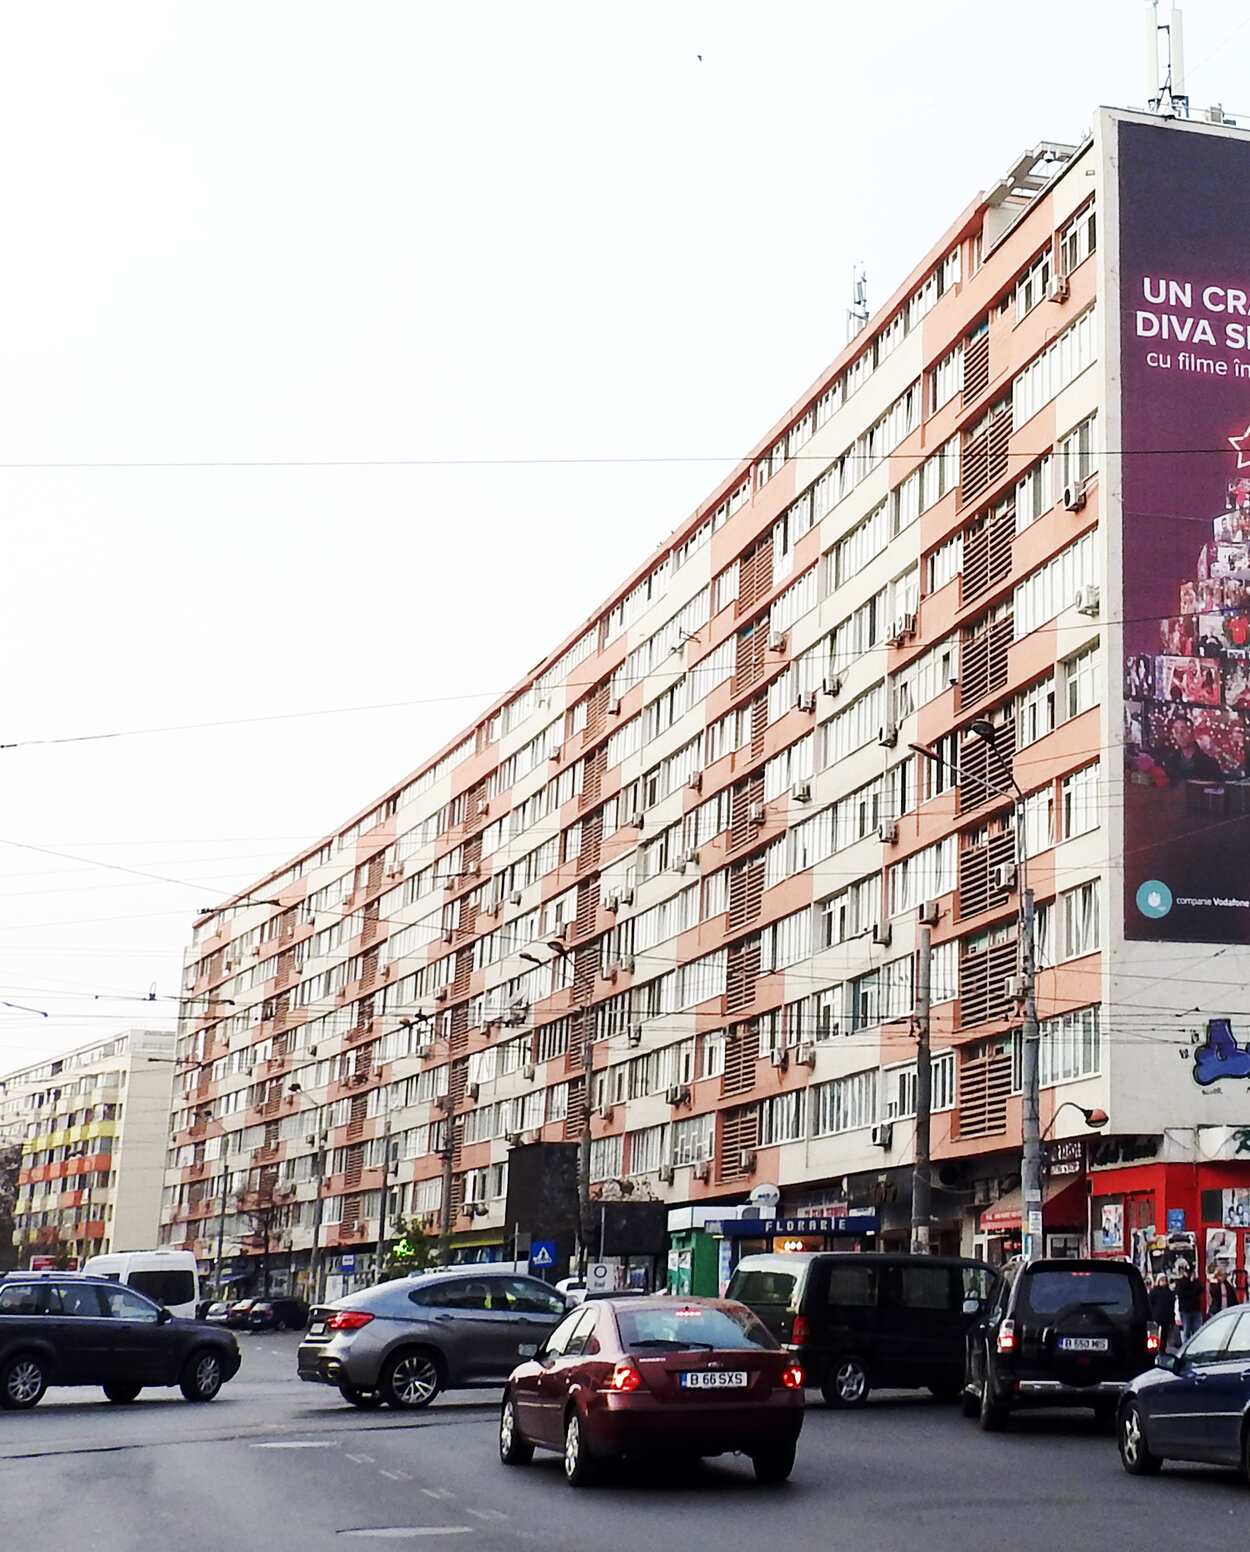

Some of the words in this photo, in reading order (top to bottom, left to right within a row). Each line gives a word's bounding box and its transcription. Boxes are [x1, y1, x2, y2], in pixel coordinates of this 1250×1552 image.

[1143, 277, 1192, 308] UN
[1136, 310, 1217, 346] DIVA
[1146, 352, 1171, 369] cu
[1177, 352, 1228, 376] filme
[1176, 896, 1212, 907] companie
[1213, 897, 1250, 908] Vodafone
[765, 1217, 847, 1232] FLORARIE
[690, 1373, 698, 1385] B
[703, 1373, 716, 1385] 66
[719, 1373, 743, 1385] SXS
